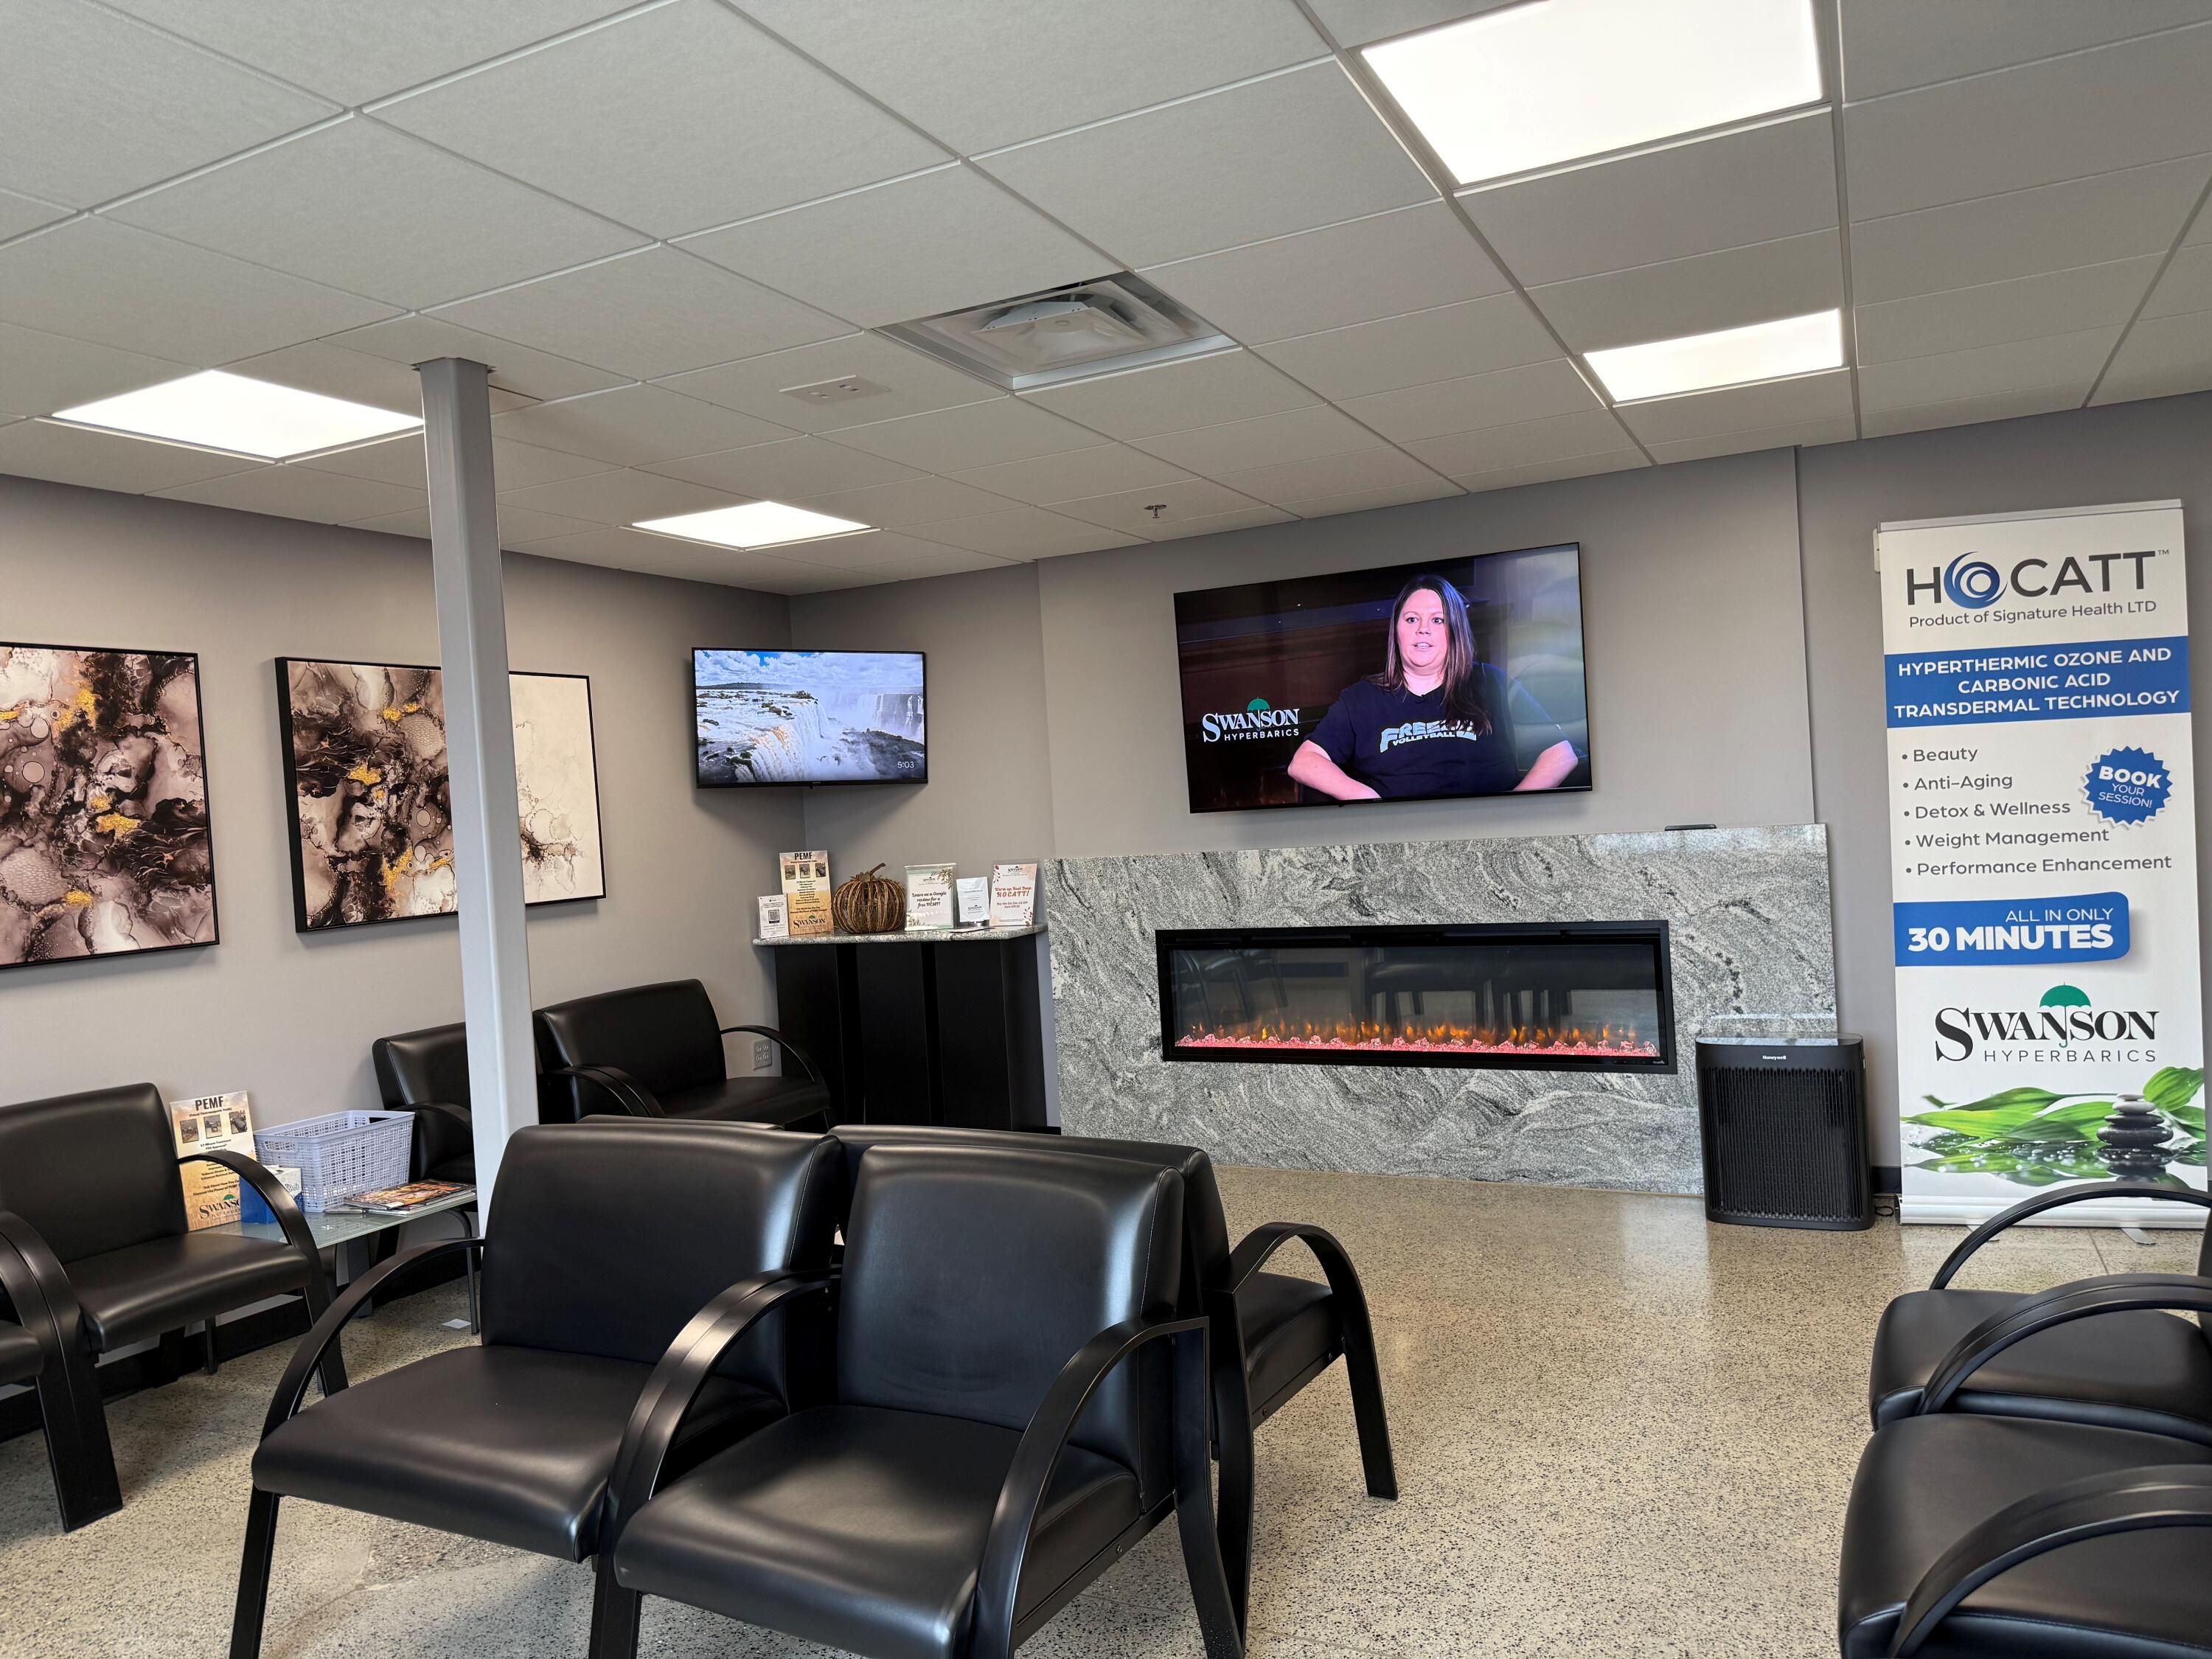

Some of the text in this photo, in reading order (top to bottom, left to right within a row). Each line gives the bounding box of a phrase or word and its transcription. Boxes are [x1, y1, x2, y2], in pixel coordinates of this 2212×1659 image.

[1910, 600, 2157, 627] Product of Signature Health LTD
[1899, 647, 2171, 676] HYPERTHERMIC OZONE AND
[1958, 672, 2111, 694] CARBONIC ACID
[1894, 690, 2180, 718] TRANSDERMAL TECHNOLOGY
[1203, 709, 1301, 742] SWANSON
[1224, 728, 1300, 742] HYPERBARICS
[1913, 748, 1978, 762] Beauty
[1914, 774, 2013, 790] Anti-Aging
[2098, 765, 2162, 789] BOOK
[2112, 783, 2145, 796] YOUR
[2098, 791, 2153, 808] SESSION!
[1916, 801, 2070, 819] Detox & Wellness
[1916, 829, 2109, 849] Weight Management
[794, 852, 813, 860] PEMF
[1917, 855, 2171, 875] Performance Enhancement
[2005, 908, 2113, 922] ALL IN ONLY
[1907, 924, 2114, 952] 30 MINUTES
[1935, 1007, 2159, 1062] SWANSON
[1984, 1050, 2156, 1062] HYPERBARICS
[195, 1096, 223, 1111] PEMF
